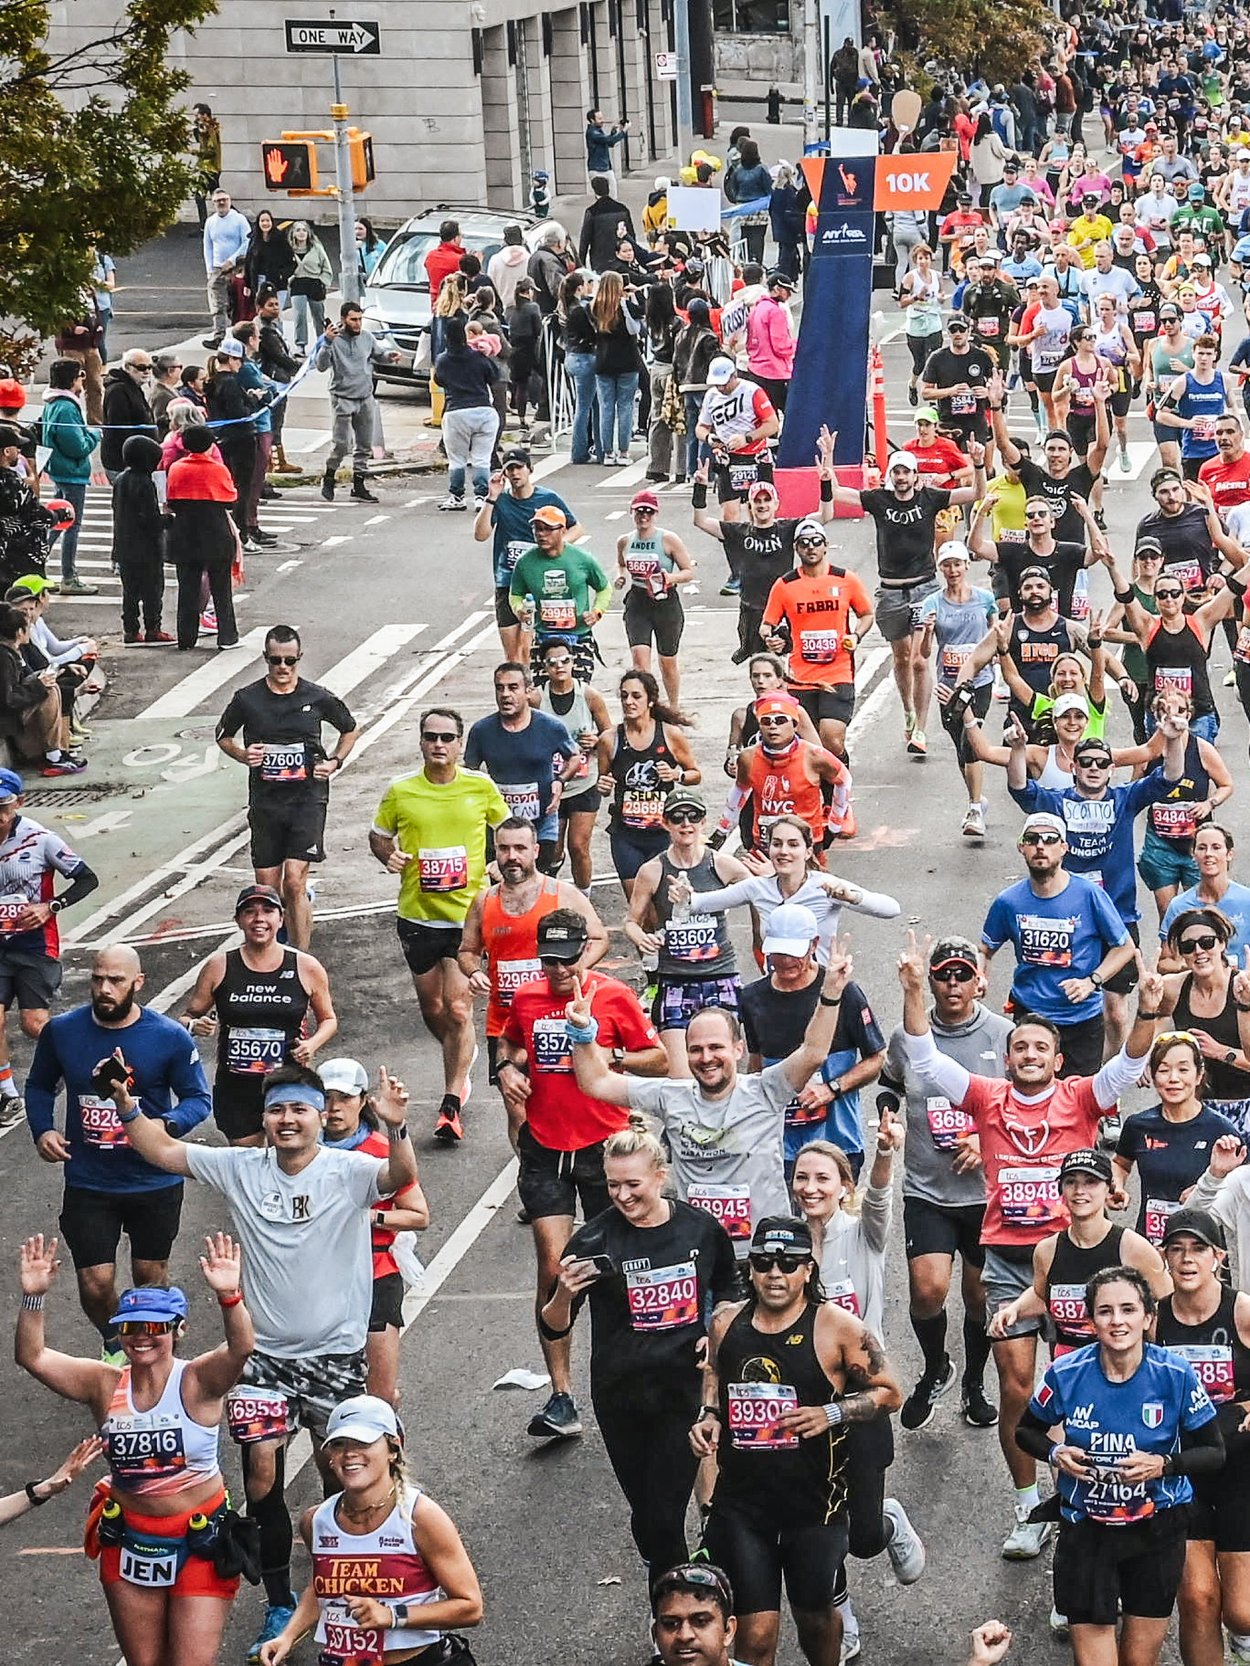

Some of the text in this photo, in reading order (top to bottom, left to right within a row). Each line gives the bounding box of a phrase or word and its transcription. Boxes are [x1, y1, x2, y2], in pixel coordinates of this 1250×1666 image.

[298, 29, 366, 44] ONE WAY
[886, 173, 932, 192] 10K
[885, 504, 923, 526] SCOTT
[630, 542, 656, 550] ANDEE
[627, 560, 657, 573] 36672
[541, 607, 575, 620] 29948
[796, 600, 840, 615] FABRI
[801, 638, 837, 651] 30439
[263, 753, 303, 766] 37600
[624, 801, 664, 815] 29698
[761, 800, 795, 813] NYC
[1079, 836, 1106, 847] TEAM
[422, 857, 465, 874] 38715
[668, 929, 716, 945] 33602
[1023, 929, 1070, 947] 31620
[246, 983, 278, 994] new
[229, 991, 292, 1004] balance
[230, 1039, 282, 1058] 35670
[1065, 1158, 1097, 1167] HAPPY
[1001, 1181, 1059, 1201] 38948
[632, 1279, 695, 1309] 32840
[1065, 1417, 1099, 1430] MICAP
[113, 1430, 177, 1456] 37816
[1091, 1432, 1136, 1451] PINA
[122, 1556, 173, 1583] JEN
[329, 1558, 382, 1578] TEAM
[314, 1576, 405, 1595] CHICKEN
[327, 1630, 378, 1652] 39152
